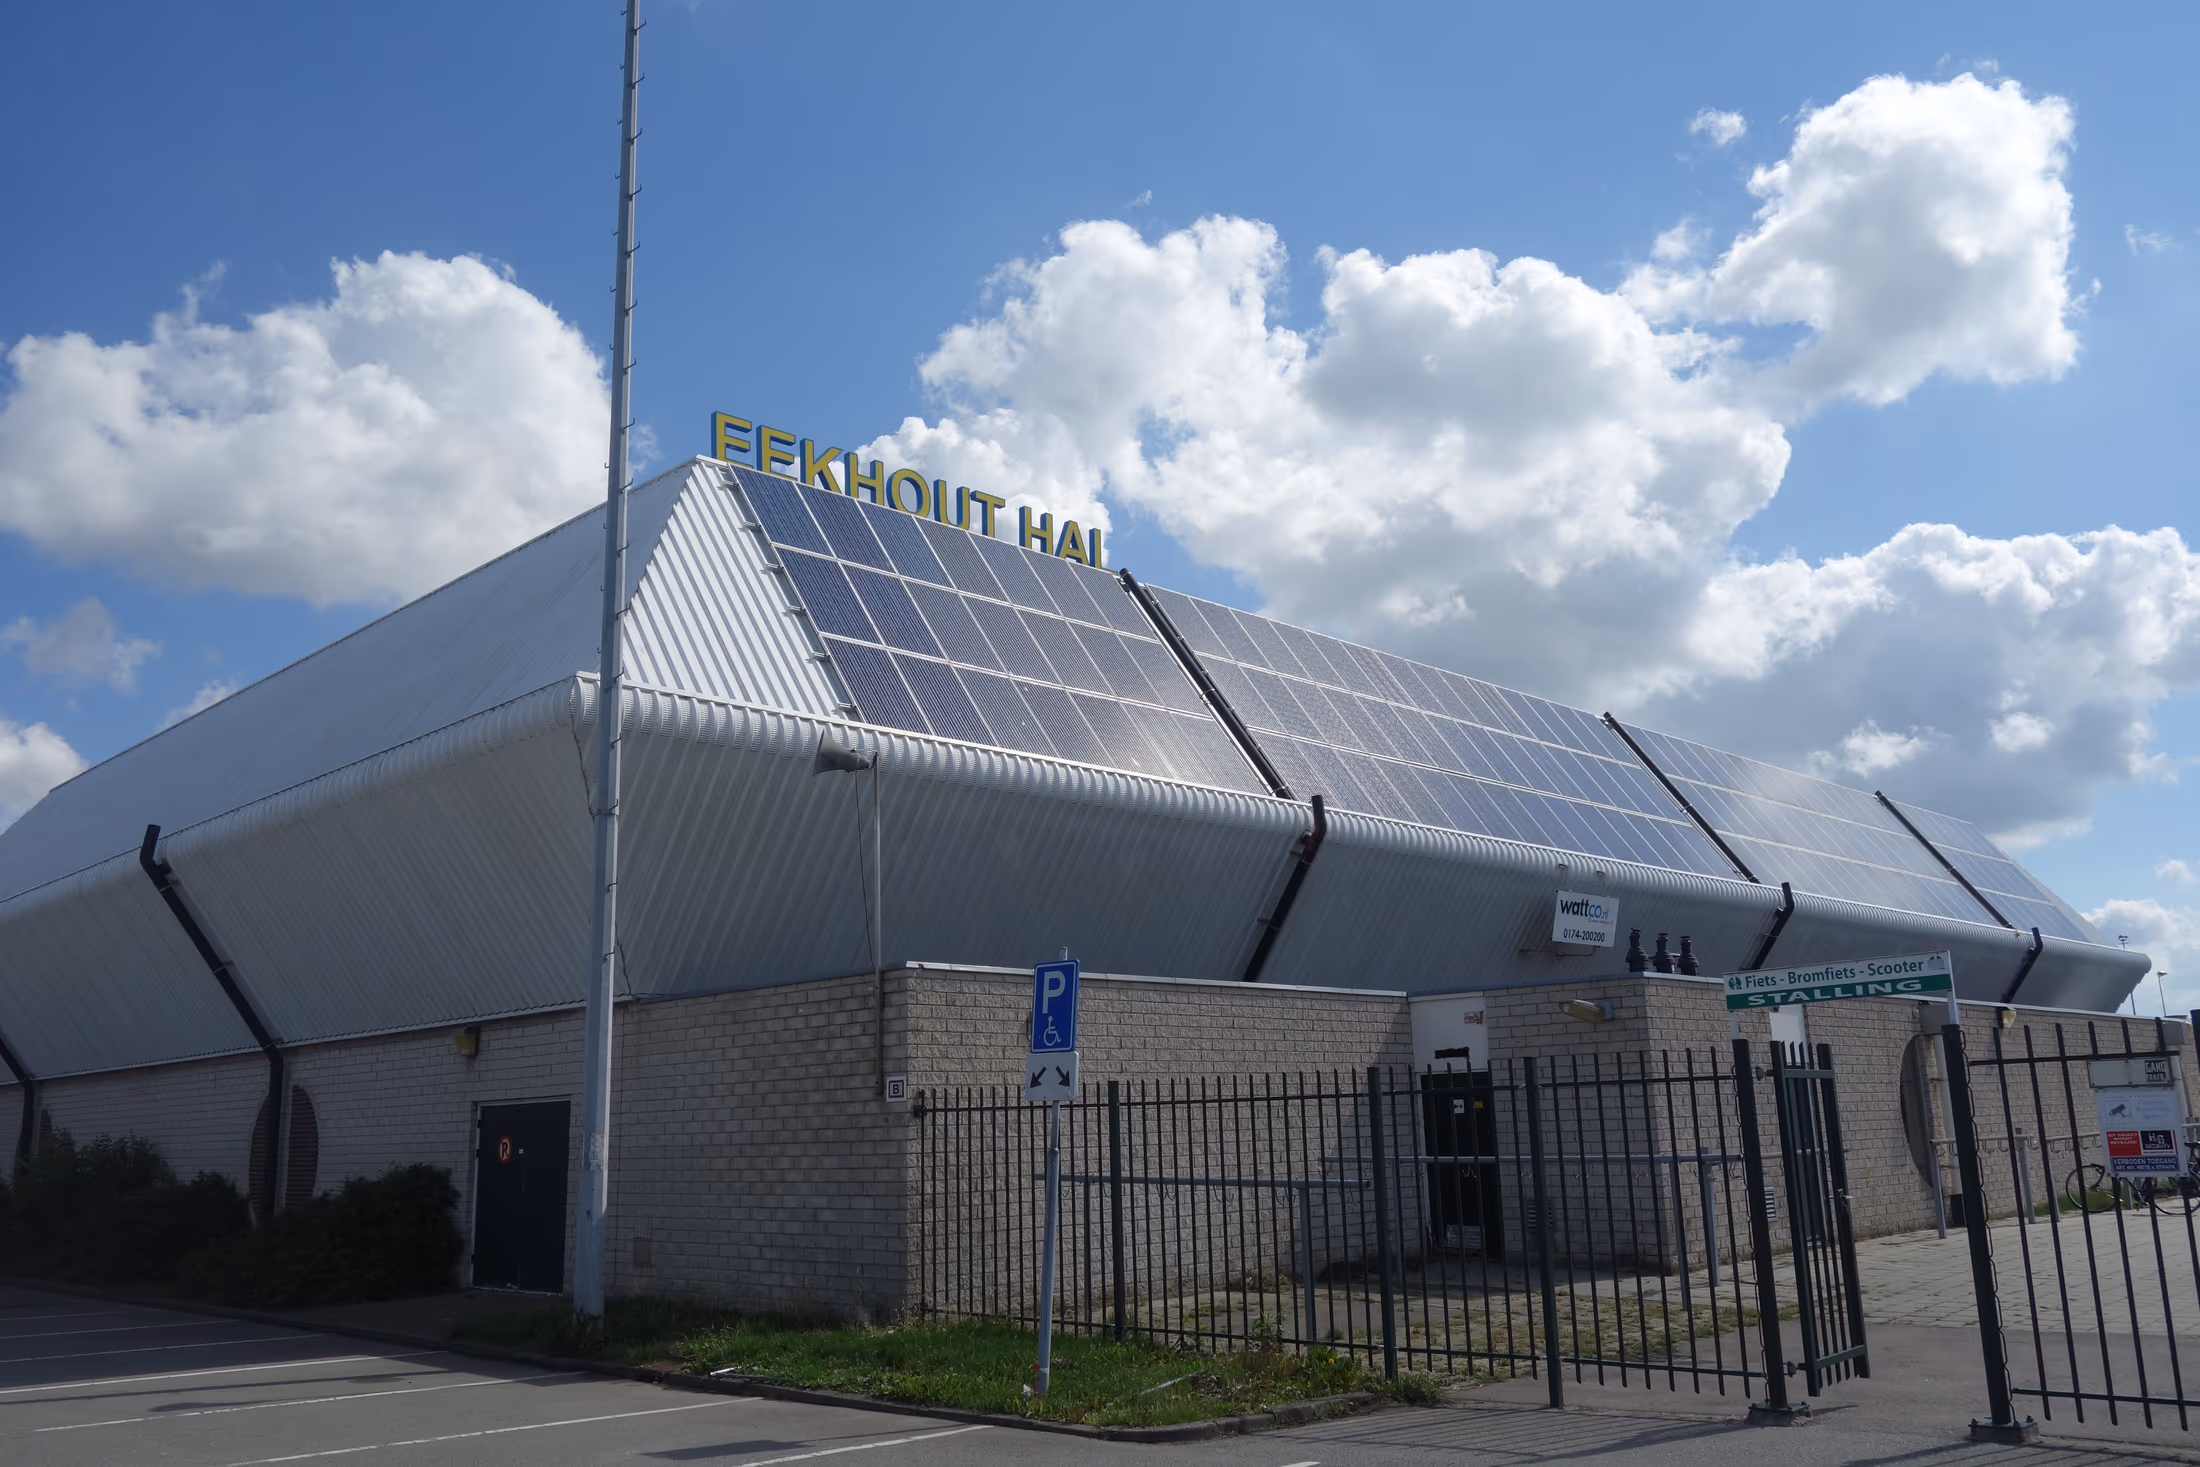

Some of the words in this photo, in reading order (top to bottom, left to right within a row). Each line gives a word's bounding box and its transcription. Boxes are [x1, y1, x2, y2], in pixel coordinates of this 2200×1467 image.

[711, 411, 1005, 539] EEKHOUT
[1560, 898, 1609, 919] wattco.nl
[1563, 928, 1605, 942] 0174-200200
[1745, 975, 1777, 989] Fiets
[1788, 967, 1856, 984] Bromfiets
[1867, 959, 1924, 976] Scooter
[1042, 970, 1066, 1014] P
[1748, 979, 1922, 1006] STALLING
[893, 1084, 900, 1095] B
[2147, 1157, 2177, 1165] TOEGANG
